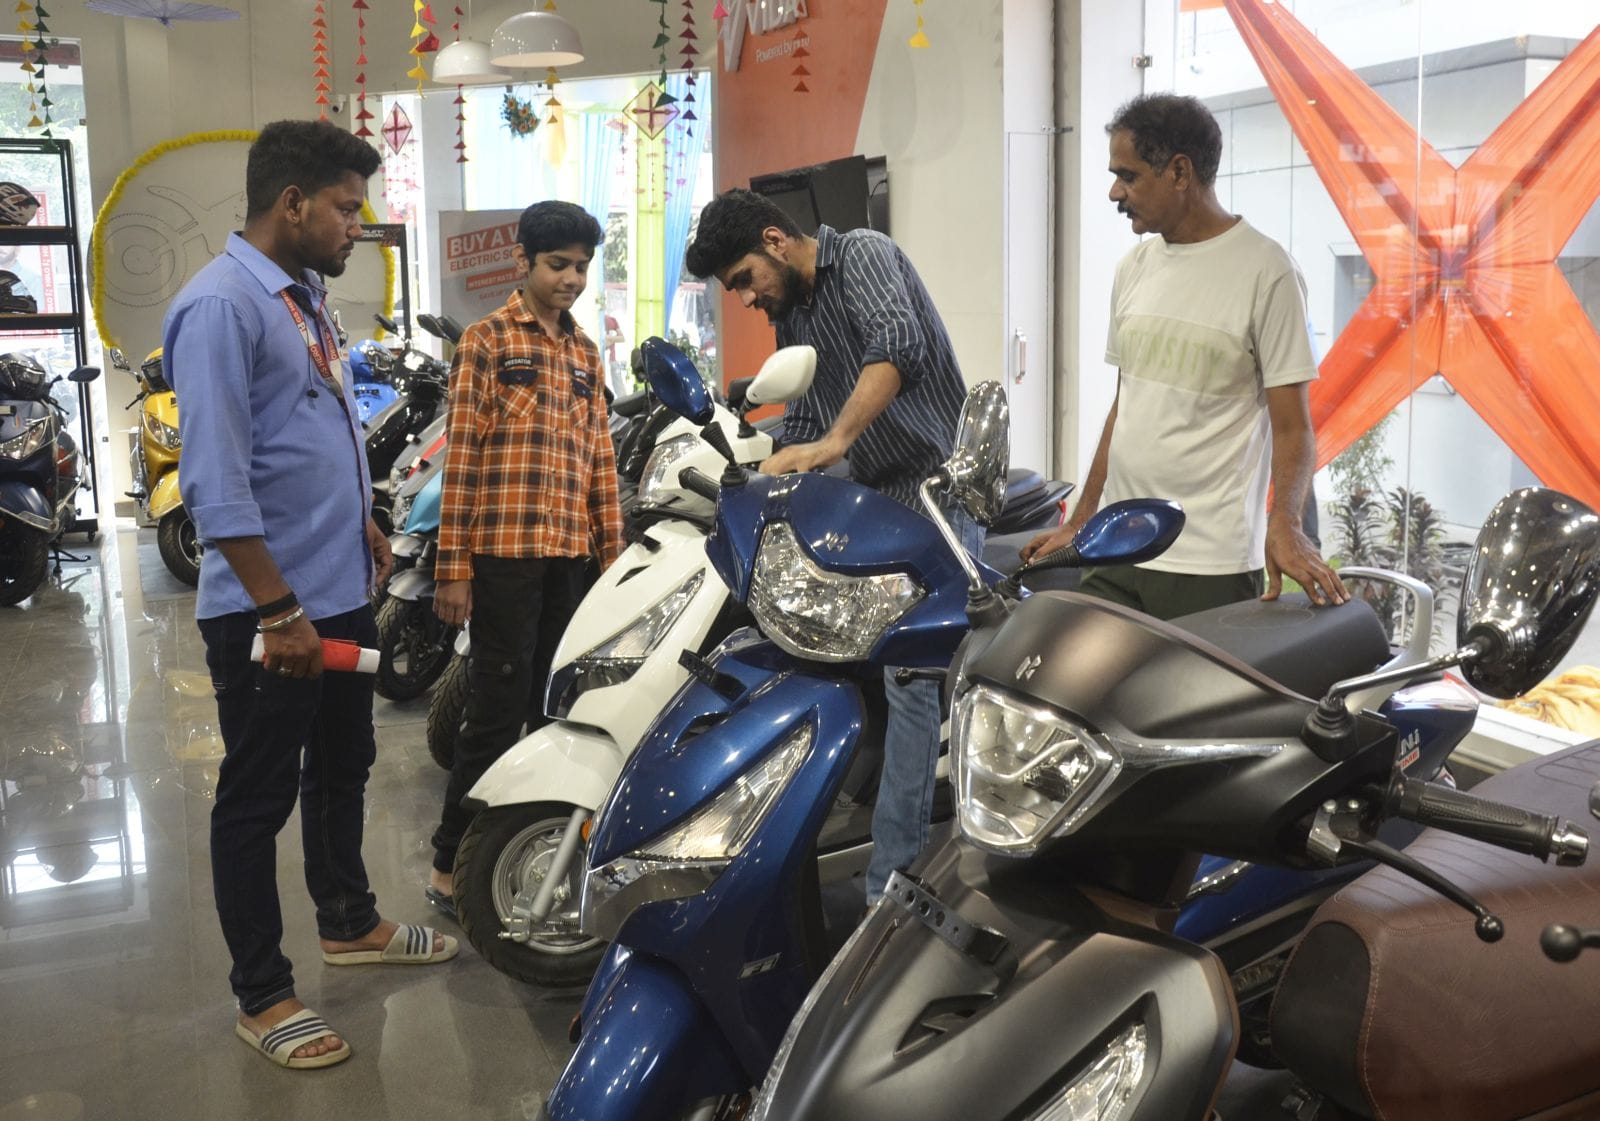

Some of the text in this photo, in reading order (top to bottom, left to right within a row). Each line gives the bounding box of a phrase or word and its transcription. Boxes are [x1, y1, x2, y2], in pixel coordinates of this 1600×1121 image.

[756, 43, 783, 63] Powered
[450, 225, 519, 256] BUY A V
[450, 251, 501, 272] ELECTRIC
[504, 358, 532, 367] PREDATOR
